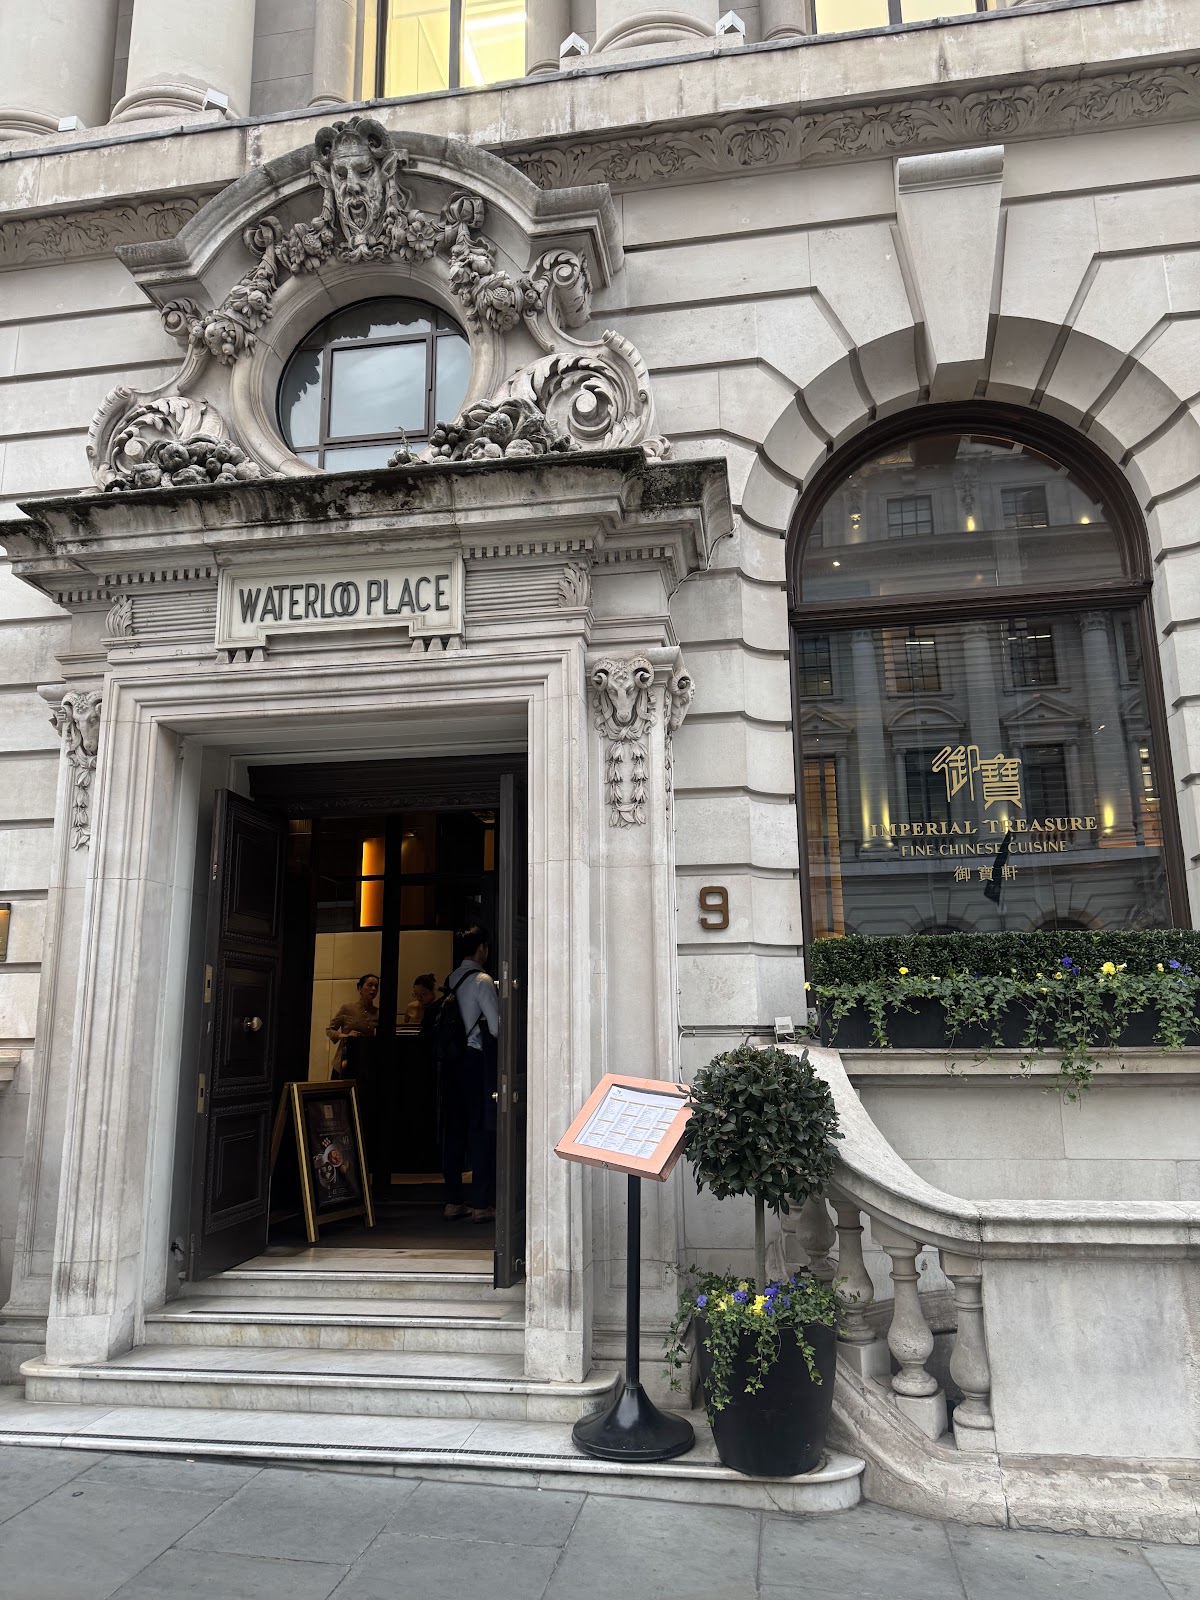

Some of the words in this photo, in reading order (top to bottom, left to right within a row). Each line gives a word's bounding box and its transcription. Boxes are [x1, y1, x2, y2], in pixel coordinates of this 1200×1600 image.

[238, 581, 360, 623] WATERLOO
[366, 574, 449, 615] PLACE
[870, 820, 978, 838] IMPERIAL
[981, 816, 1098, 834] TREASURE
[901, 844, 935, 857] FINE
[939, 842, 1003, 856] CHINESE
[1007, 840, 1068, 854] CUISINE
[699, 885, 730, 930] 9
